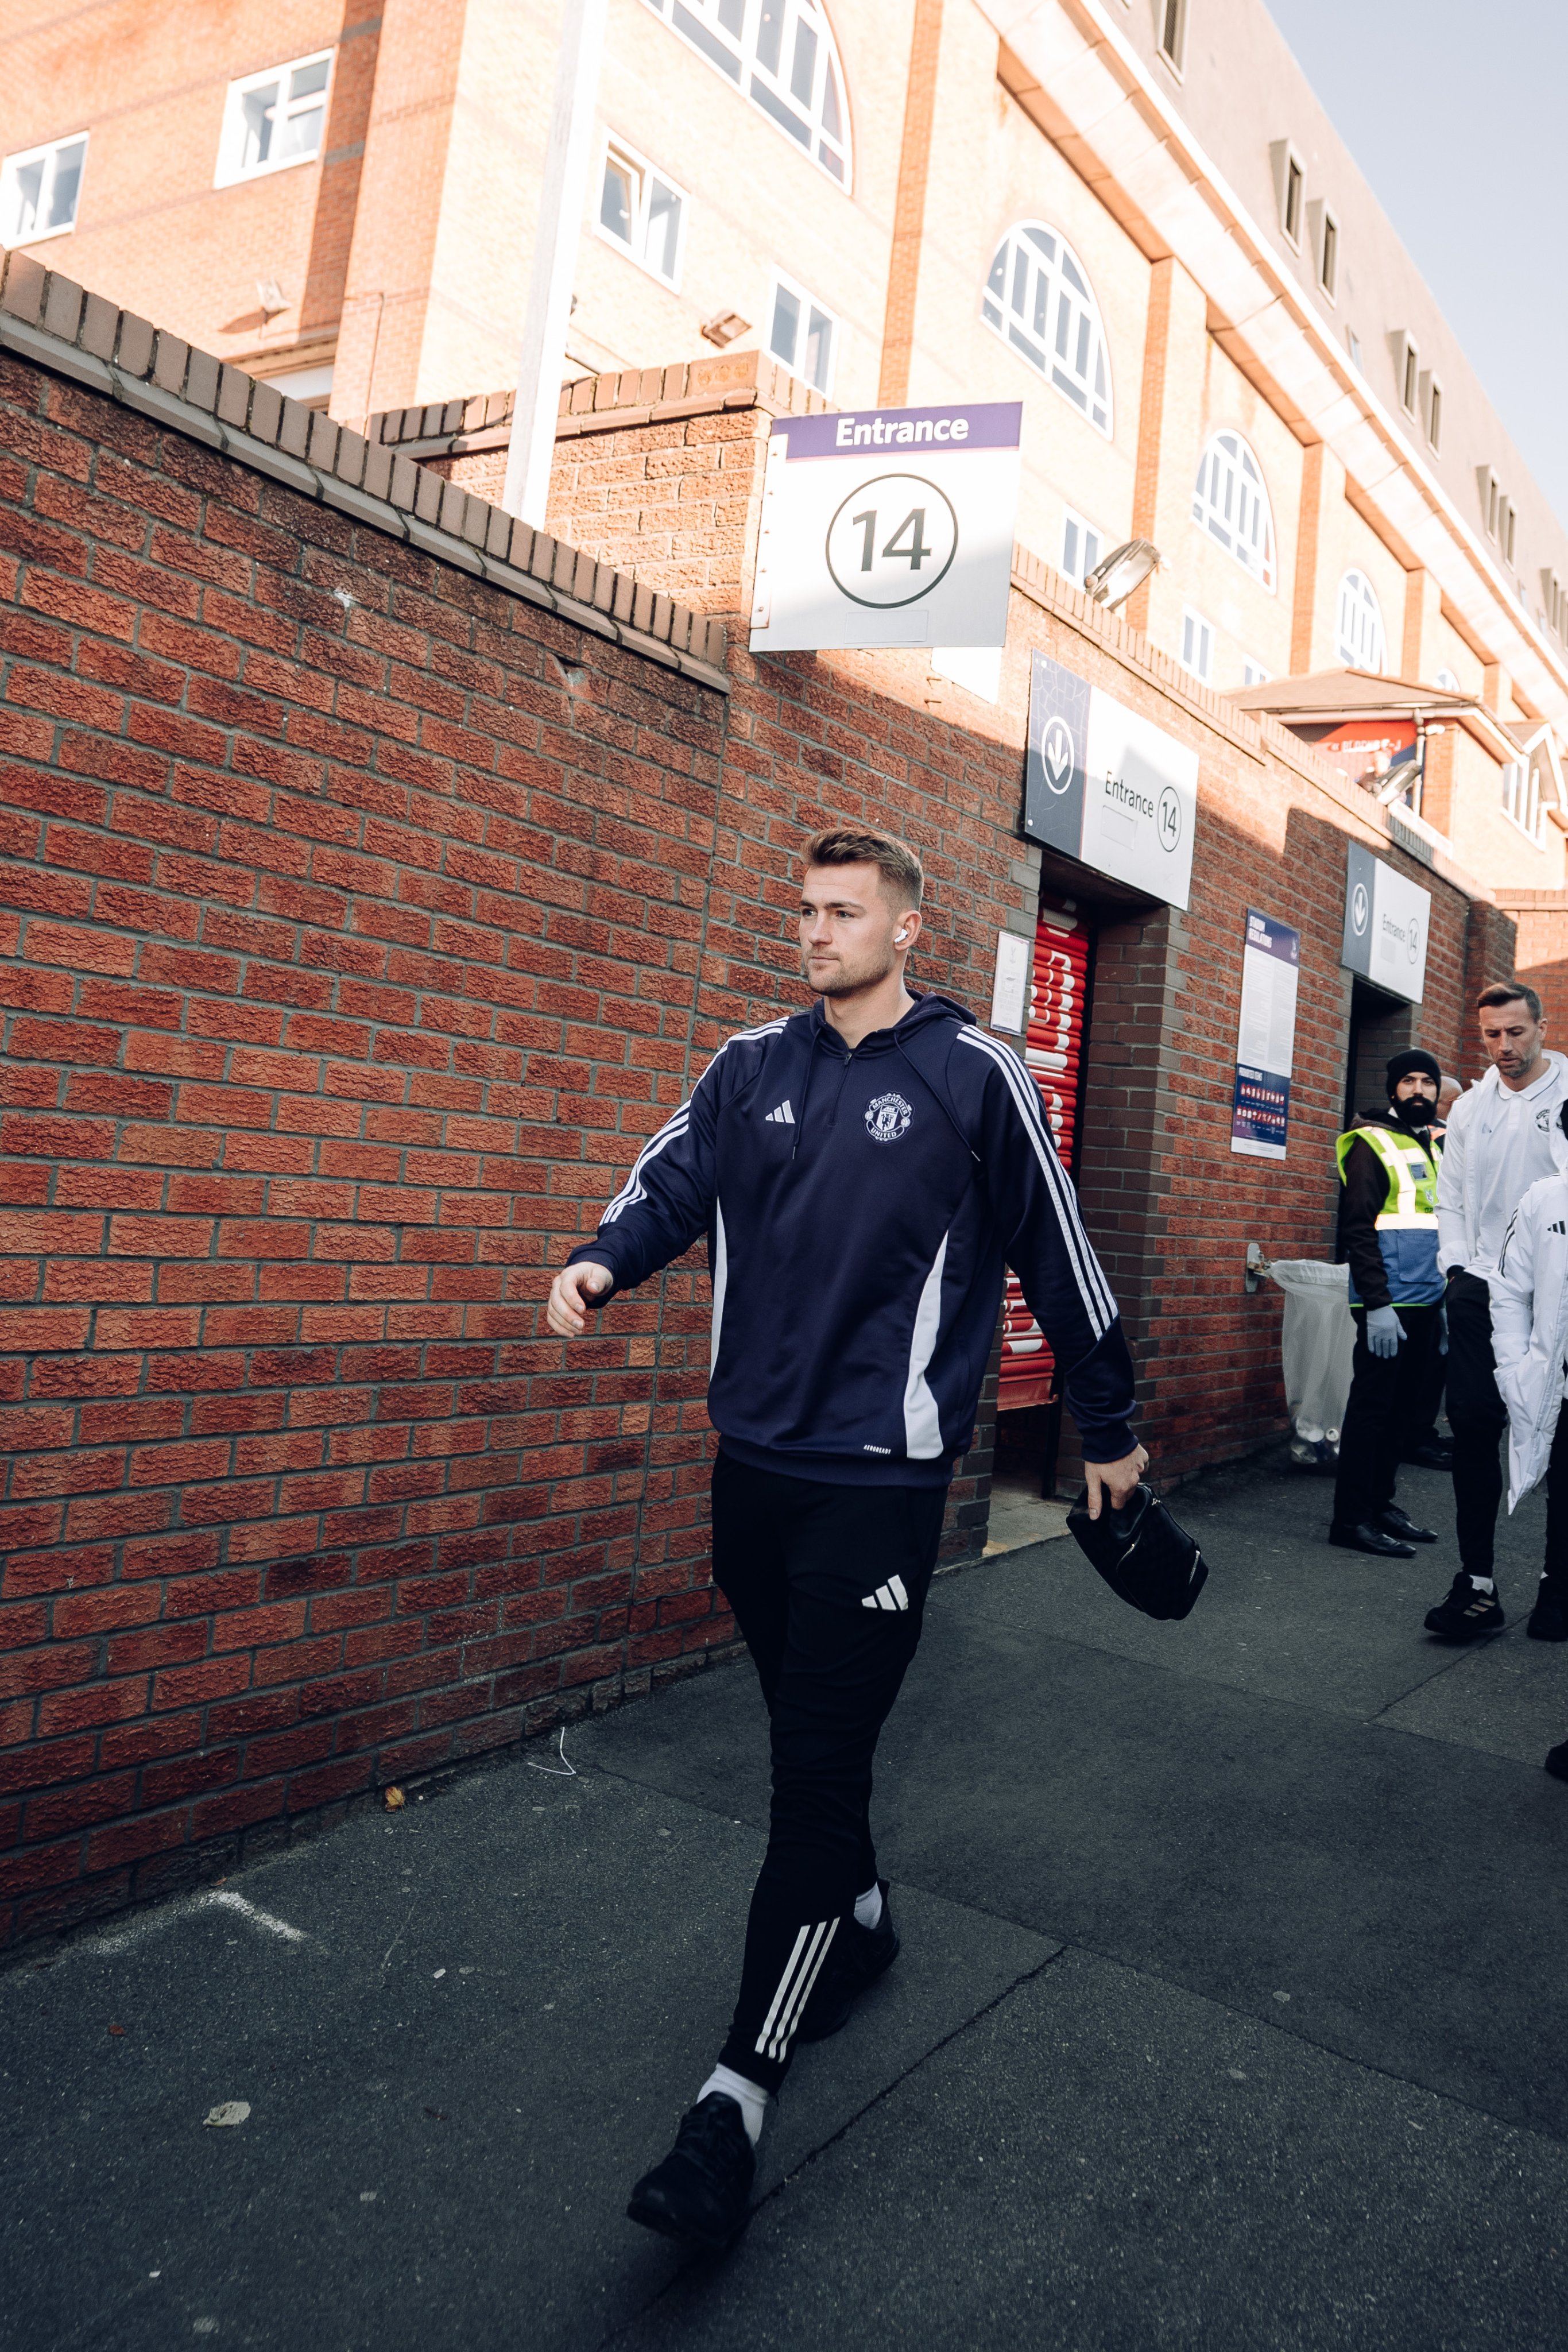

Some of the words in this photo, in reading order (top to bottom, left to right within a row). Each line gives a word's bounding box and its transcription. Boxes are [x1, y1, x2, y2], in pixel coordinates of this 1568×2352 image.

[836, 417, 969, 447] Entrance
[853, 508, 931, 572] 14
[1105, 770, 1153, 818] Entrance
[1163, 802, 1176, 837] 14
[1383, 914, 1406, 942] Entrance
[1410, 929, 1417, 953] 14
[873, 1096, 908, 1115] MANCHESTER
[870, 1127, 897, 1138] UNITED
[864, 1444, 891, 1454] AEROREADY
